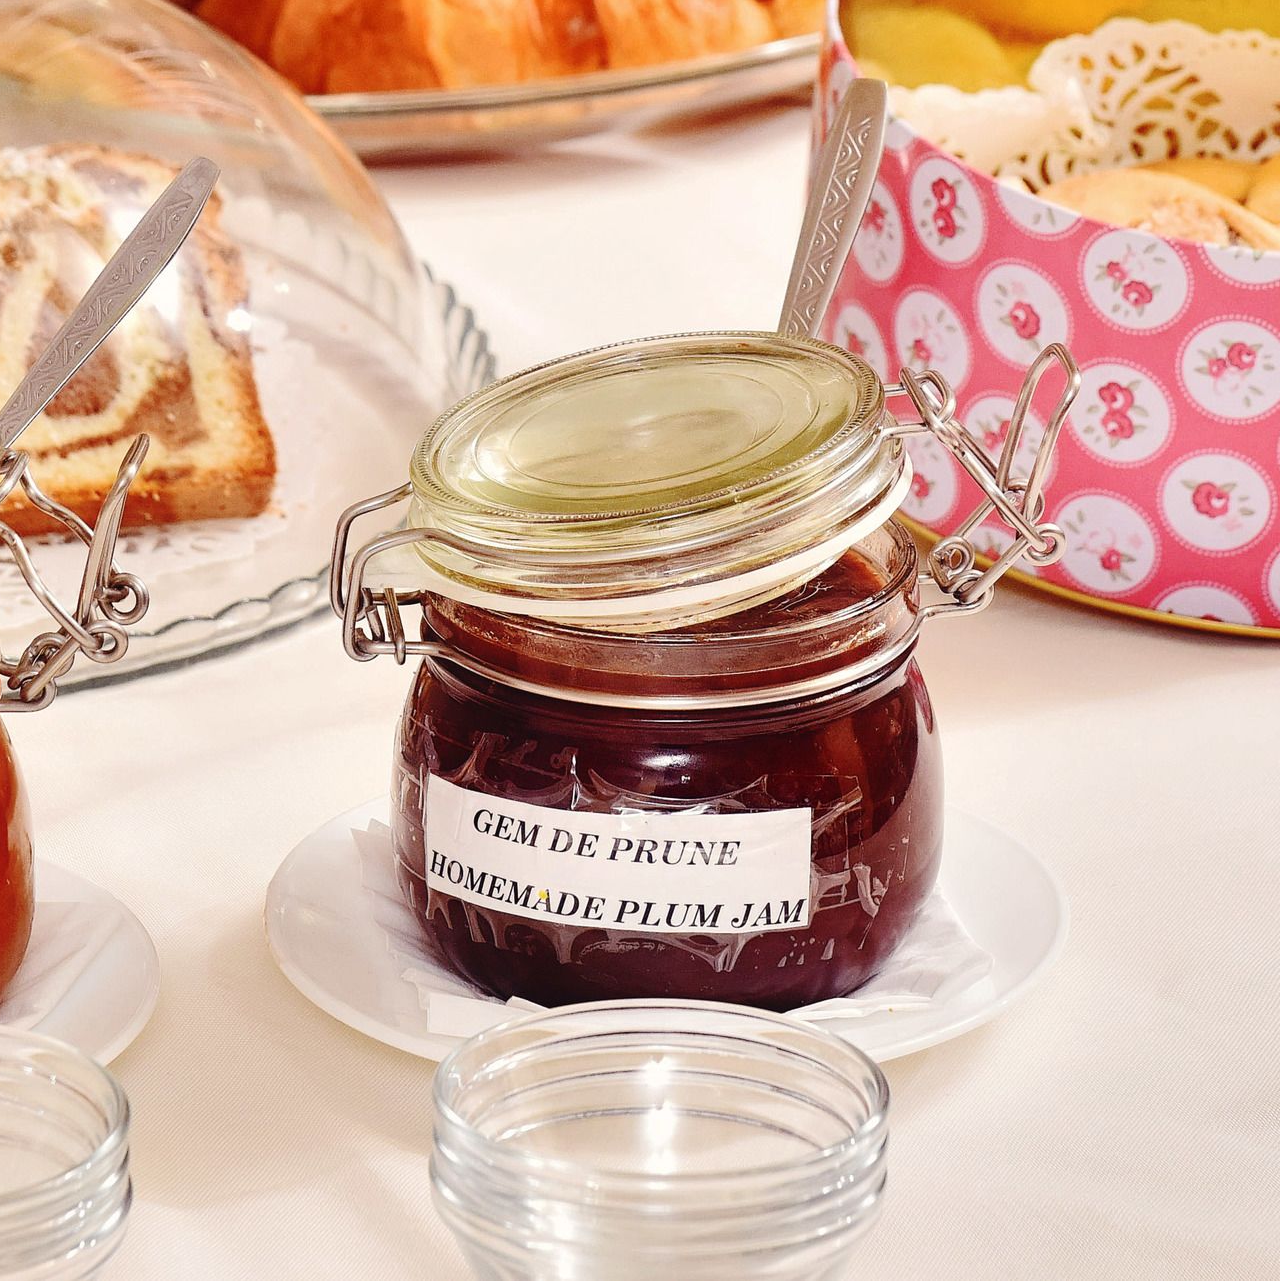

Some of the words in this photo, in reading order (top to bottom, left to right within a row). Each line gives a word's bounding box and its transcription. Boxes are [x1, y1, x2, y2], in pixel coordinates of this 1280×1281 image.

[472, 808, 542, 848] GEM
[547, 828, 600, 859] DE
[606, 838, 741, 867] PRUNE
[430, 850, 606, 921] HOMEMADE
[614, 899, 725, 929] PLUM
[730, 898, 807, 929] JAM
